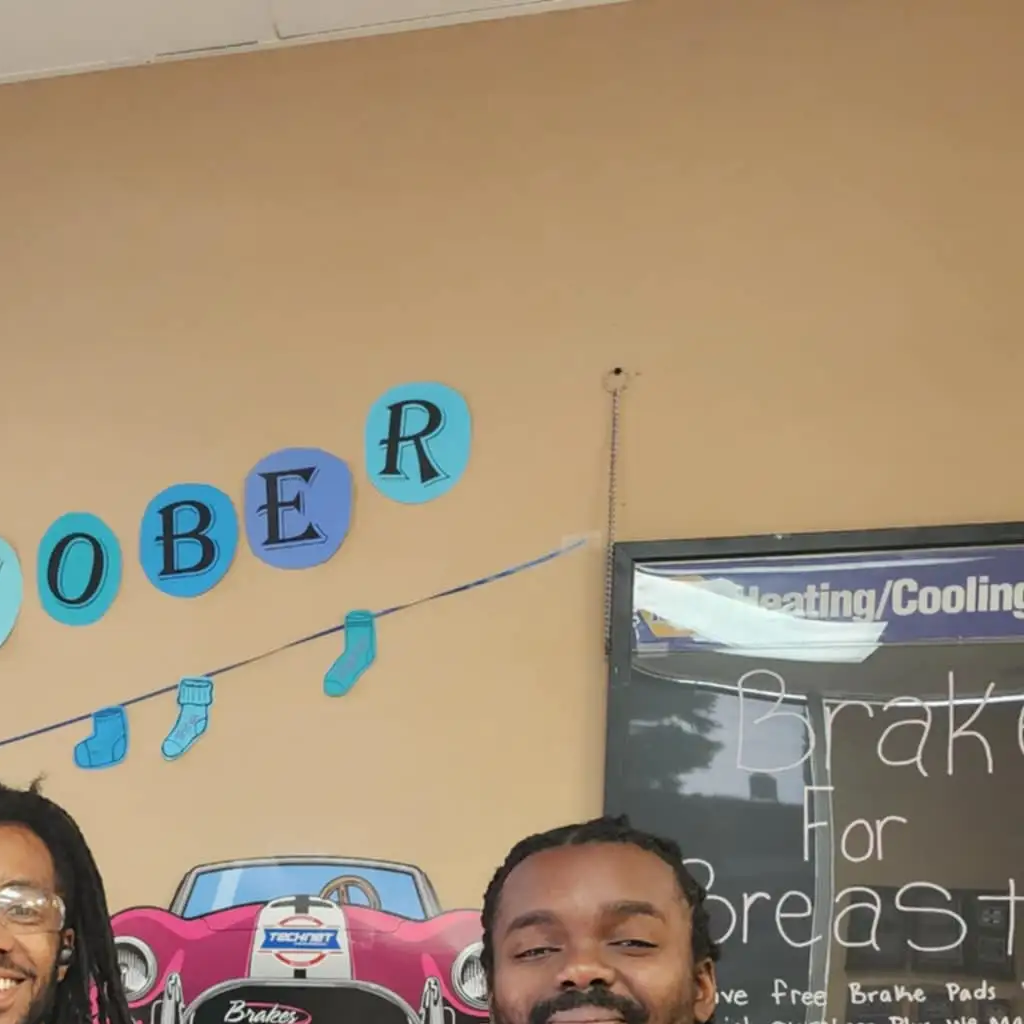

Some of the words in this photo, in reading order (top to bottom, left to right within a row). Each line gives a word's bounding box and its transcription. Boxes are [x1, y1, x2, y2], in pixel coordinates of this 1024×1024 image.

[737, 669, 1024, 776] Brak
[803, 786, 907, 861] For
[224, 1000, 299, 1024] Brakes
[772, 978, 827, 1006] free
[848, 982, 926, 1004] Brake
[946, 980, 996, 1002] Pads
